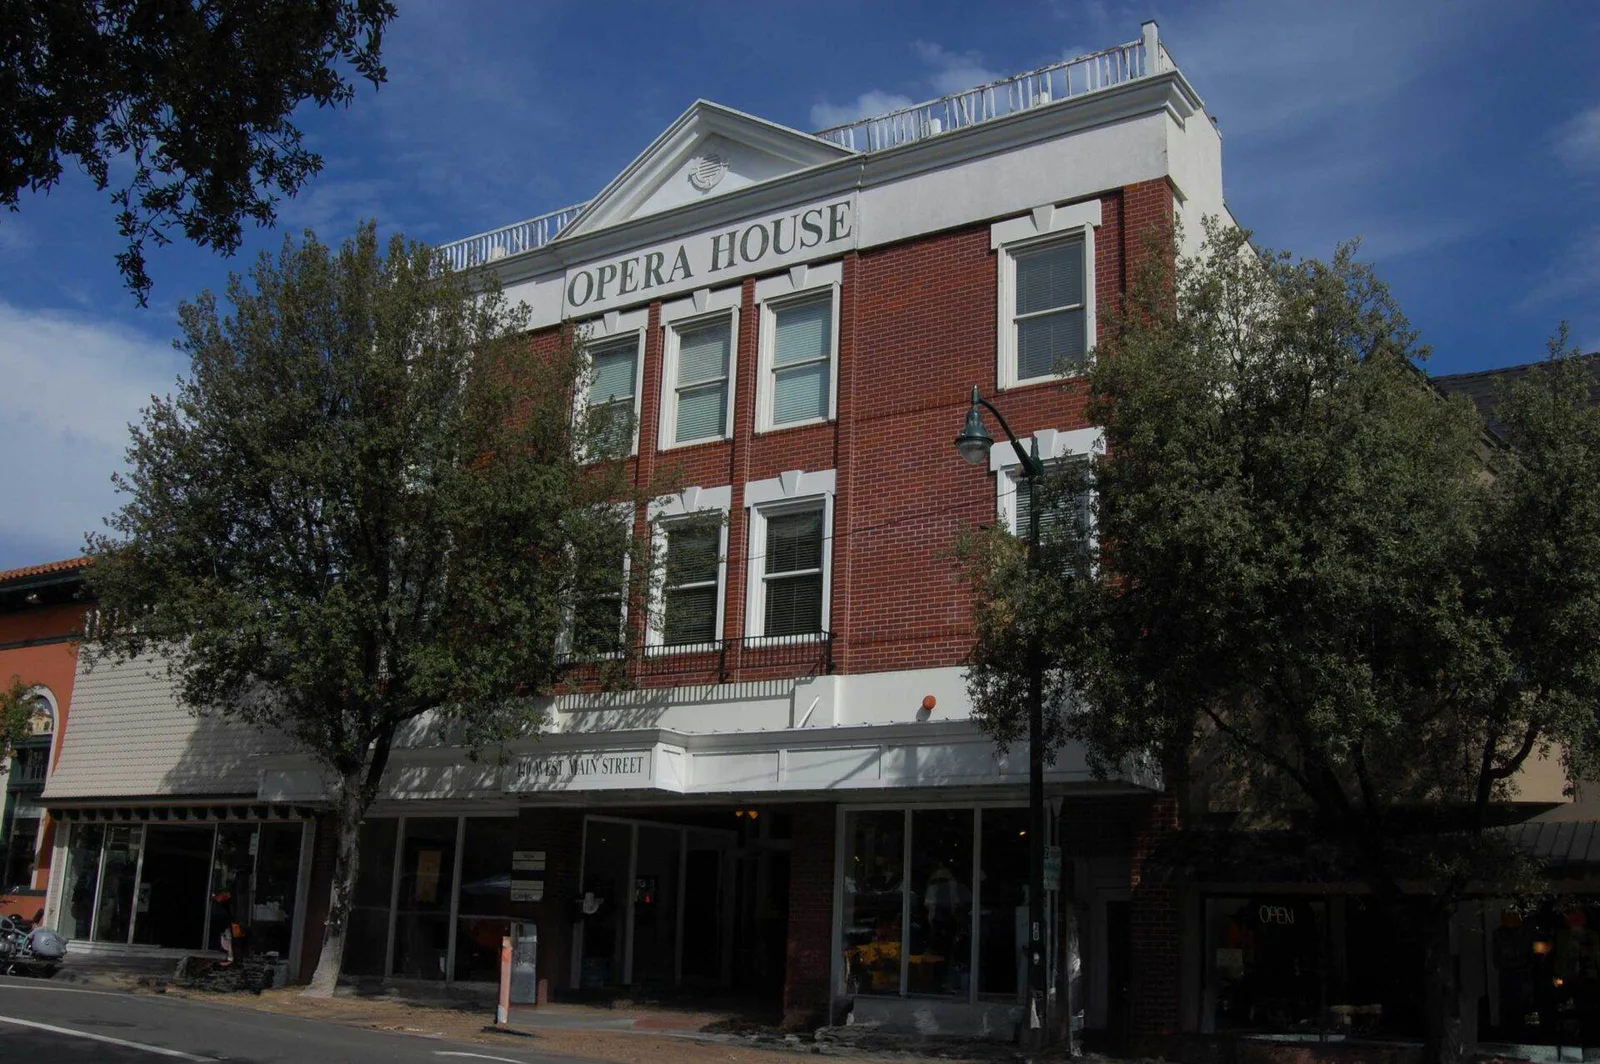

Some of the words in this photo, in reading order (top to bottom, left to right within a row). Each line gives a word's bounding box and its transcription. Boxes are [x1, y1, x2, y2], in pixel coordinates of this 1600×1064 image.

[567, 245, 694, 307] OPERA
[708, 200, 853, 273] HOUSE
[535, 760, 564, 776] WEST
[568, 758, 599, 776] MAIN
[602, 757, 644, 775] STREET
[1259, 905, 1294, 925] OPEN
